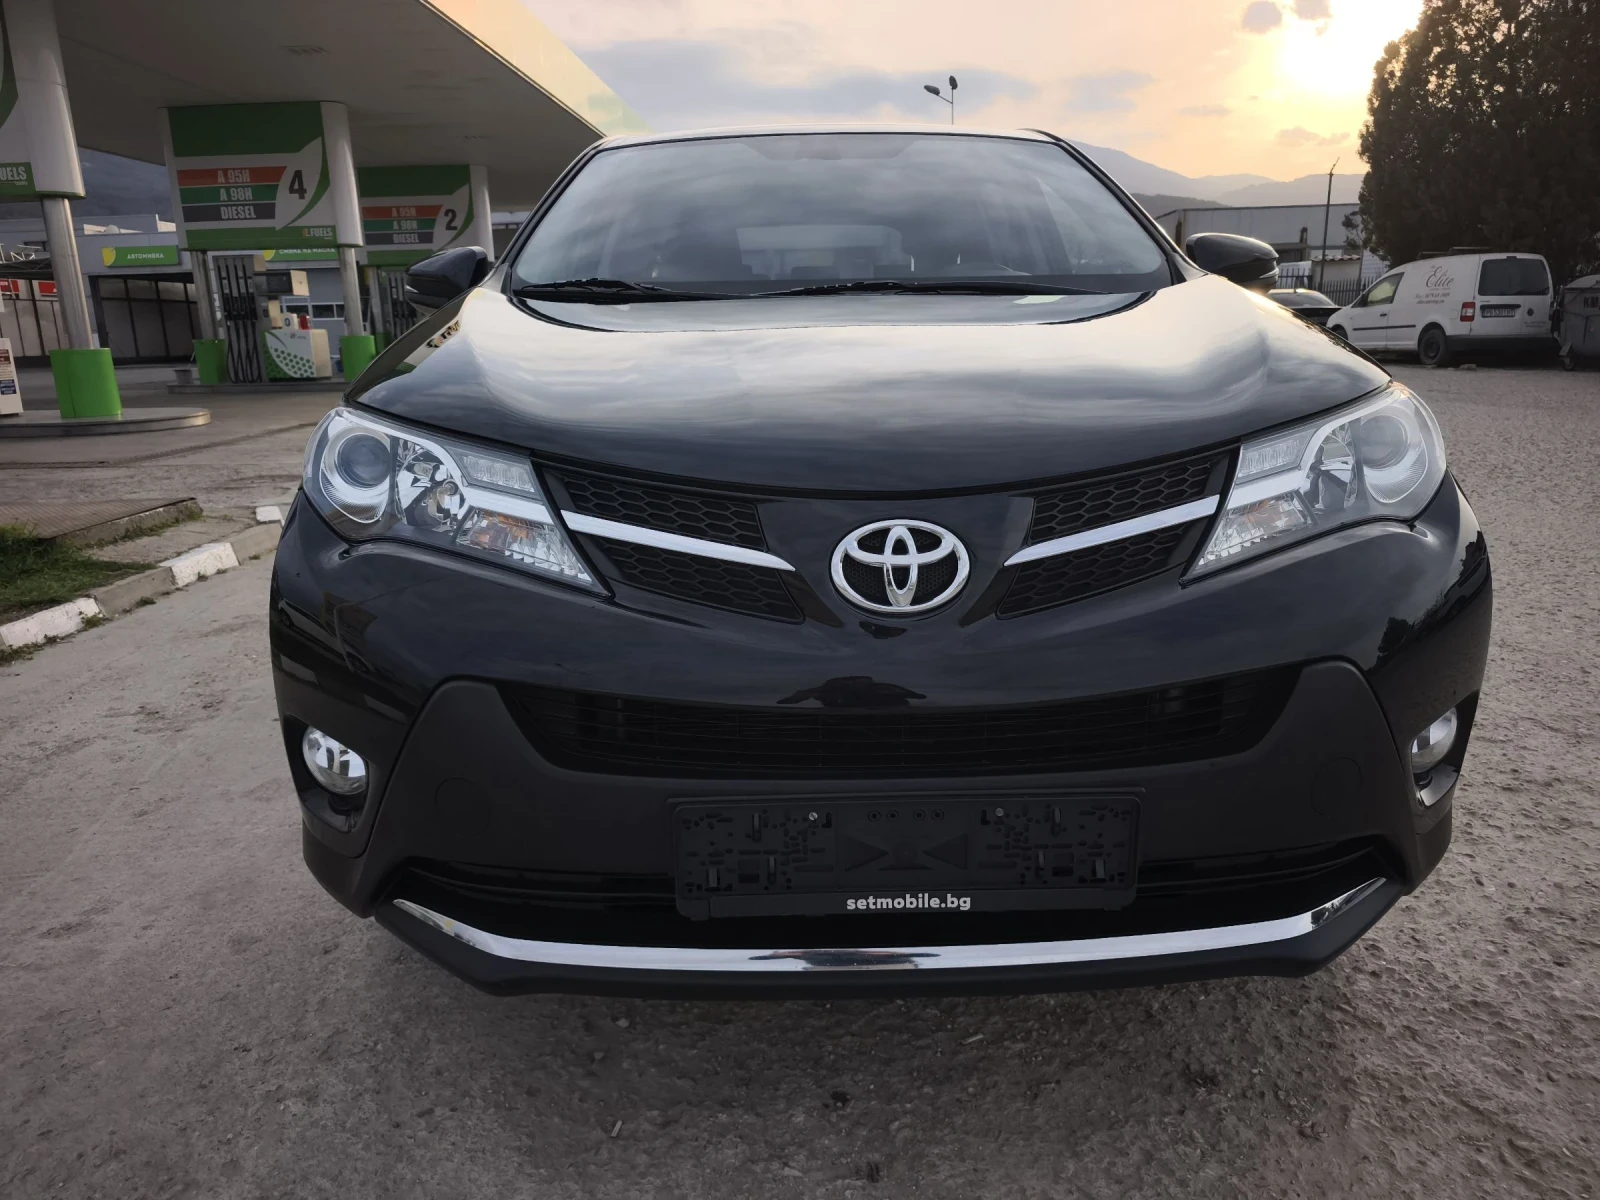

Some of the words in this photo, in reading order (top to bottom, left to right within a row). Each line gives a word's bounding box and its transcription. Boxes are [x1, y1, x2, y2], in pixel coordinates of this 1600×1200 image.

[217, 170, 226, 183] A
[288, 169, 307, 200] 4
[219, 189, 228, 201] A
[230, 187, 253, 200] 98H
[220, 205, 257, 220] DIESEL
[443, 208, 458, 231] 2
[393, 233, 420, 244] DIESEL
[127, 252, 165, 260] АВТОМИВКА
[1425, 265, 1455, 288] Elite
[846, 892, 971, 911] setmobile.bg
